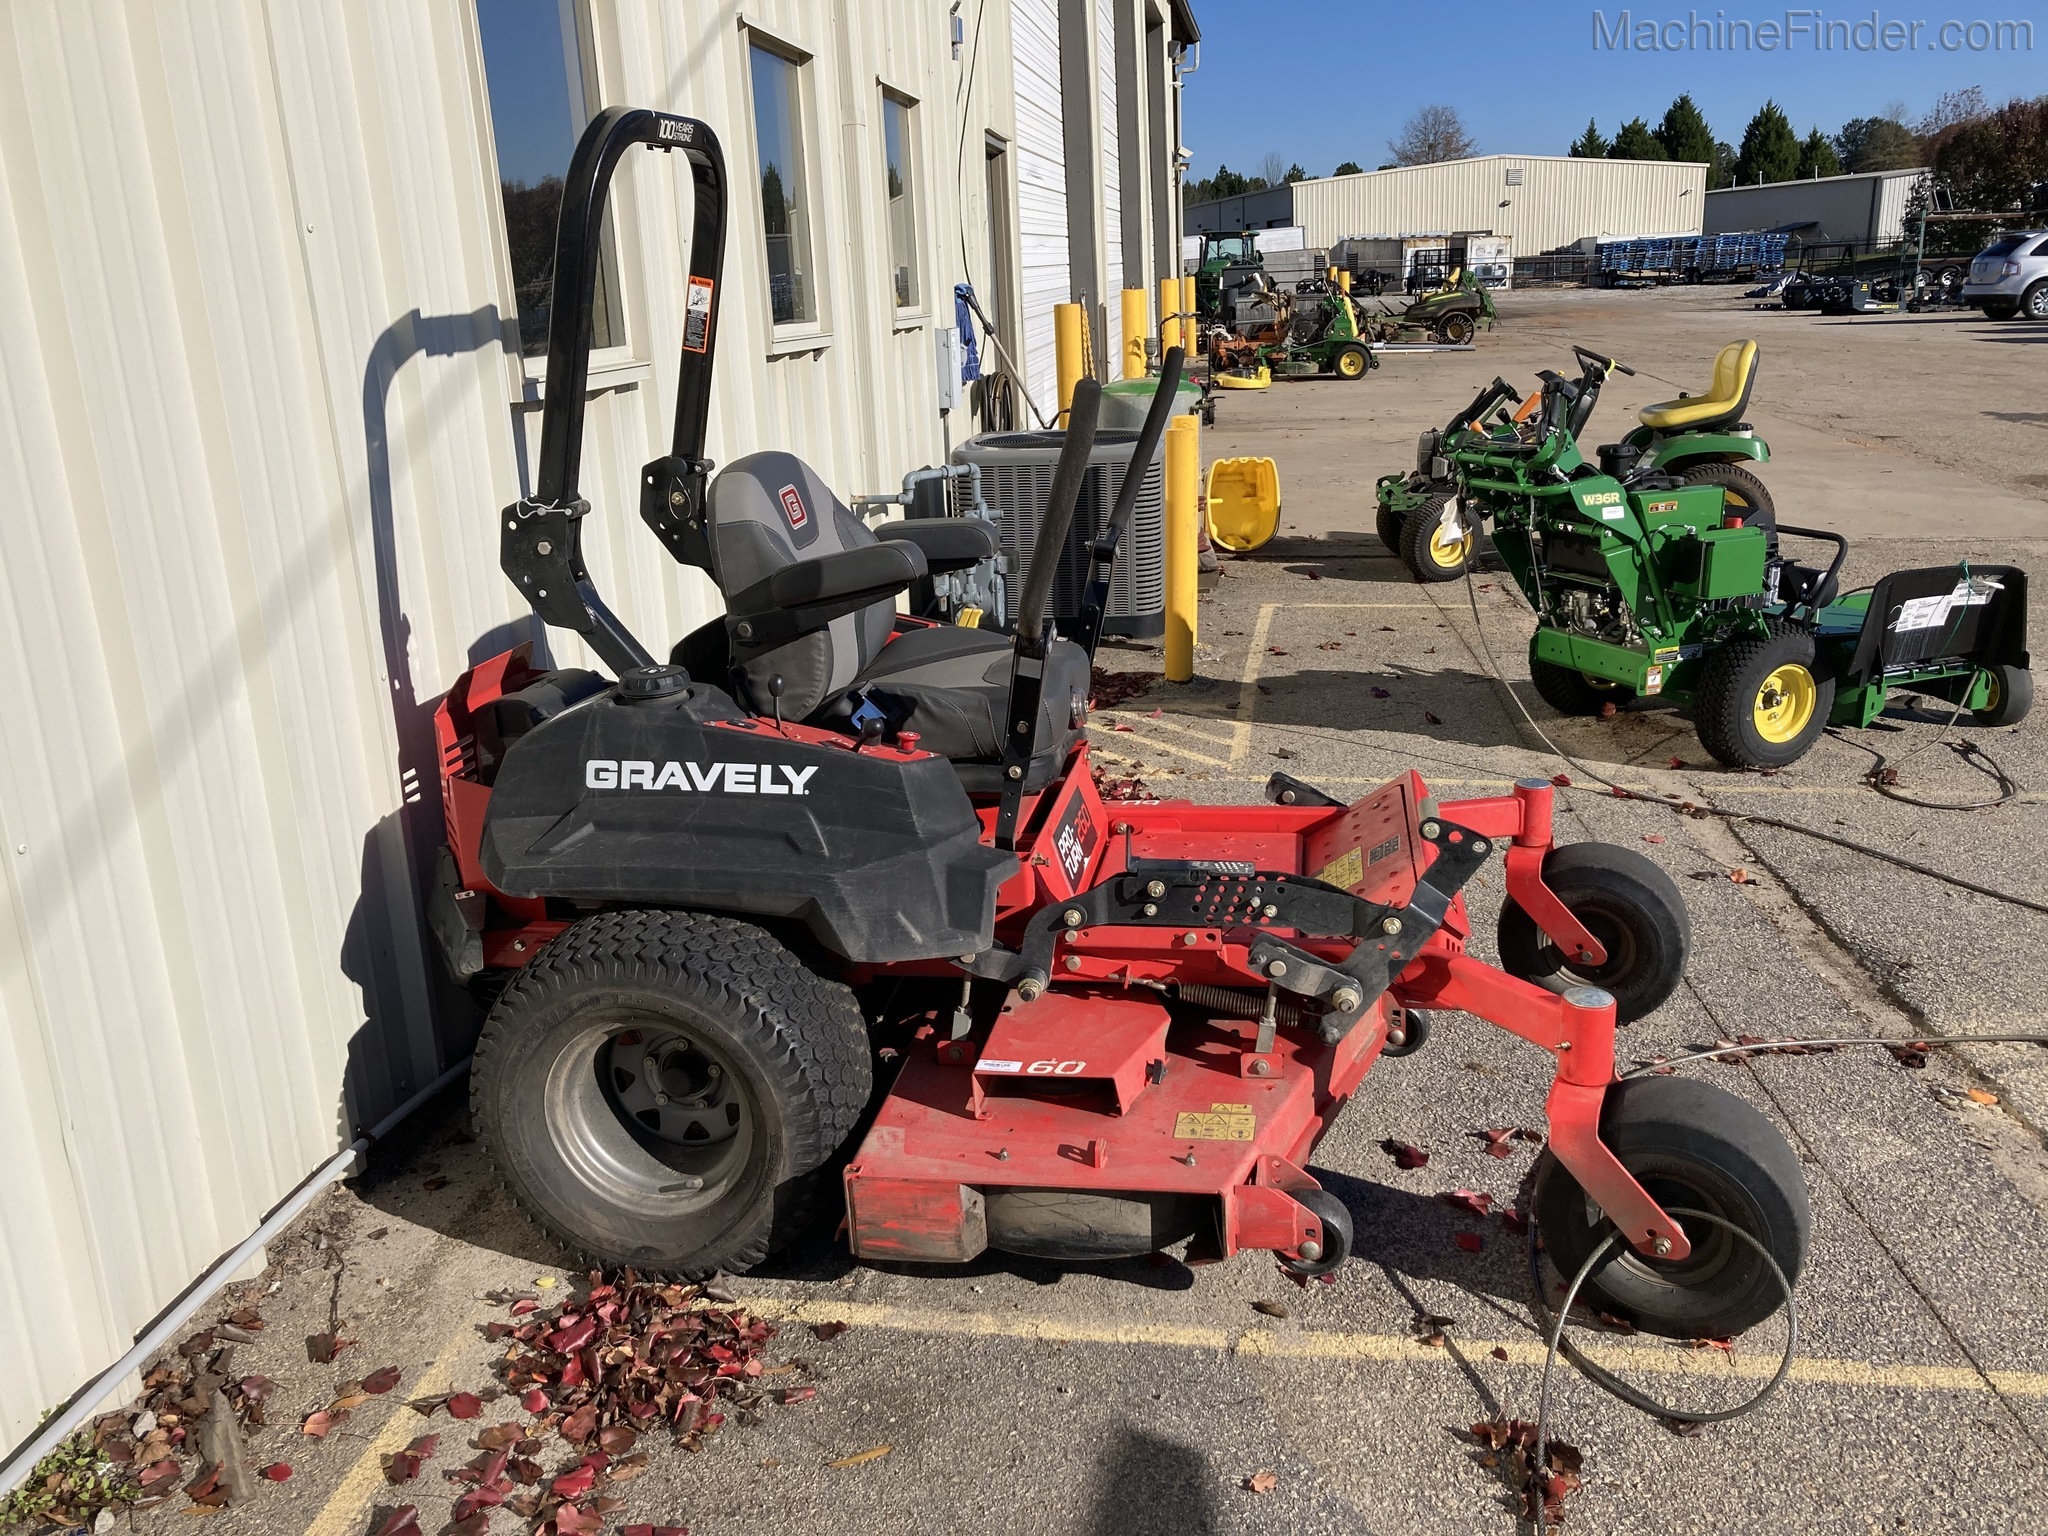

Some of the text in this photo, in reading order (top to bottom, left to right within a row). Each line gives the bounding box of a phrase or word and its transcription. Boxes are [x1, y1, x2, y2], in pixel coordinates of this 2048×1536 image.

[659, 119, 694, 139] 100 YEARS
[673, 132, 692, 142] STRONG
[1582, 492, 1621, 506] W36R
[585, 759, 819, 795] GRAVELY
[1074, 803, 1091, 843] 260
[1065, 837, 1083, 880] TURN
[1026, 1060, 1087, 1075] 60
